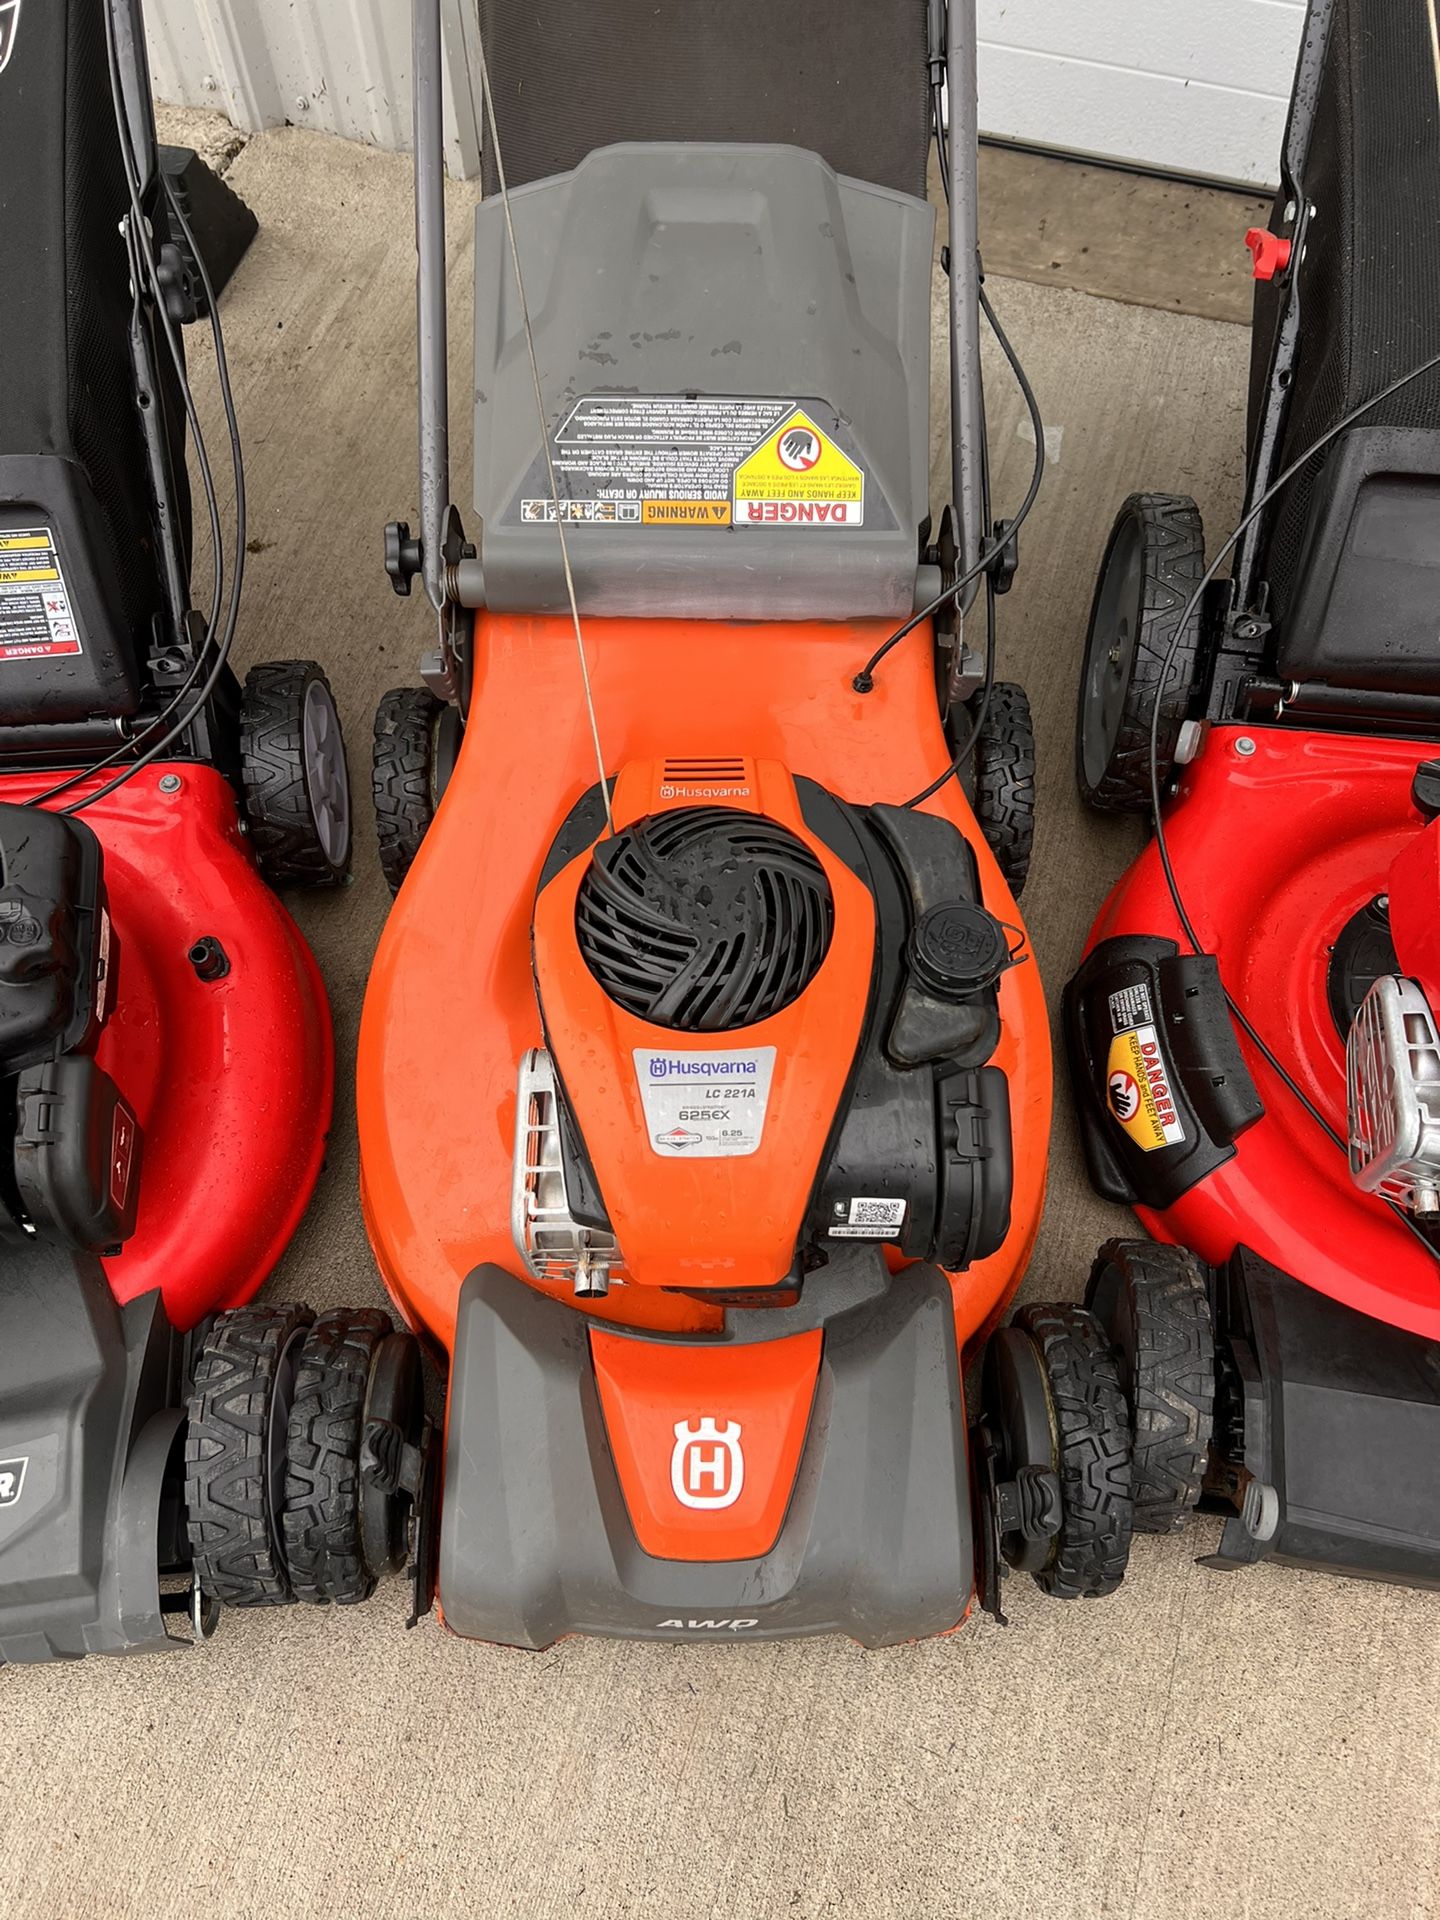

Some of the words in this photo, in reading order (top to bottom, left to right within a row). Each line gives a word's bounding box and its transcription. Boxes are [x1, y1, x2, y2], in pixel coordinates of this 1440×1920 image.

[596, 489, 624, 498] DEATH:
[626, 490, 637, 499] OR
[640, 490, 666, 499] INJURY
[669, 490, 702, 500] SERIOUS
[704, 491, 728, 500] AVOID
[740, 488, 764, 497] AWAY
[767, 489, 785, 497] FEET
[788, 490, 804, 498] AND
[806, 490, 834, 498] HANDS
[837, 490, 856, 498] KEEP
[648, 506, 708, 518] WARNING
[748, 502, 846, 522] DANGER
[5, 646, 43, 655] DANGER
[676, 787, 750, 797] Husqvarna
[1129, 1036, 1139, 1056] KEEP
[669, 1060, 756, 1076] Husqvarna
[1134, 1058, 1146, 1082] HANDS
[1141, 1042, 1175, 1126] DANGER
[706, 1089, 720, 1098] LC
[724, 1089, 756, 1098] 221A
[1140, 1084, 1150, 1098] and
[1144, 1100, 1156, 1117] FEET
[1150, 1120, 1164, 1142] AWAY
[656, 1619, 759, 1628] AWD
